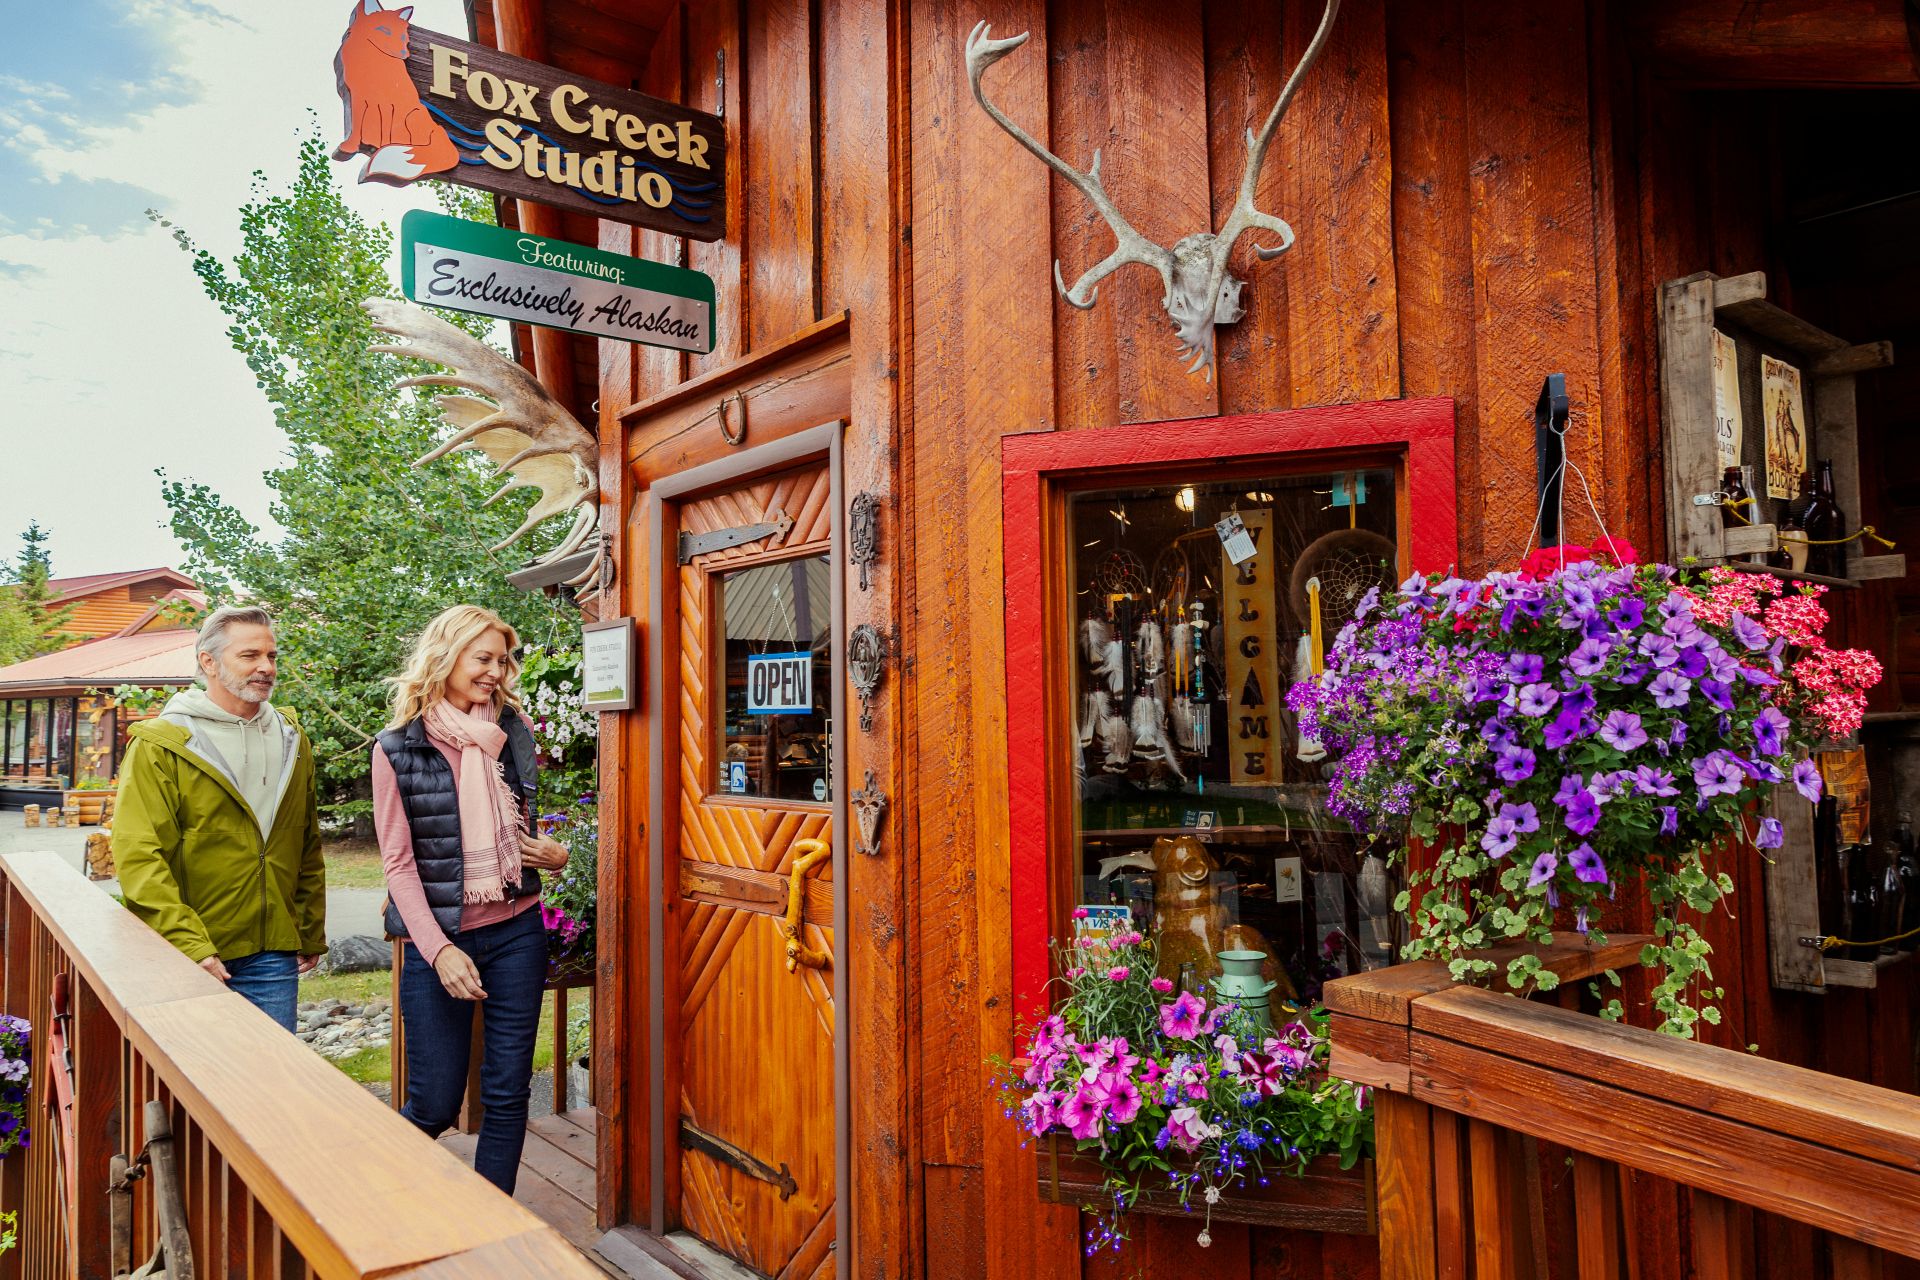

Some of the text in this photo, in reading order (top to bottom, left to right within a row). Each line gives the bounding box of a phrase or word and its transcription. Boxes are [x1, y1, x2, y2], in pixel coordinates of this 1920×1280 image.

[429, 43, 711, 170] Fox Creek
[480, 118, 673, 209] Studio
[428, 258, 699, 340] Exclusively Alaskan
[516, 238, 626, 284] Featuring:
[753, 660, 807, 706] OPEN
